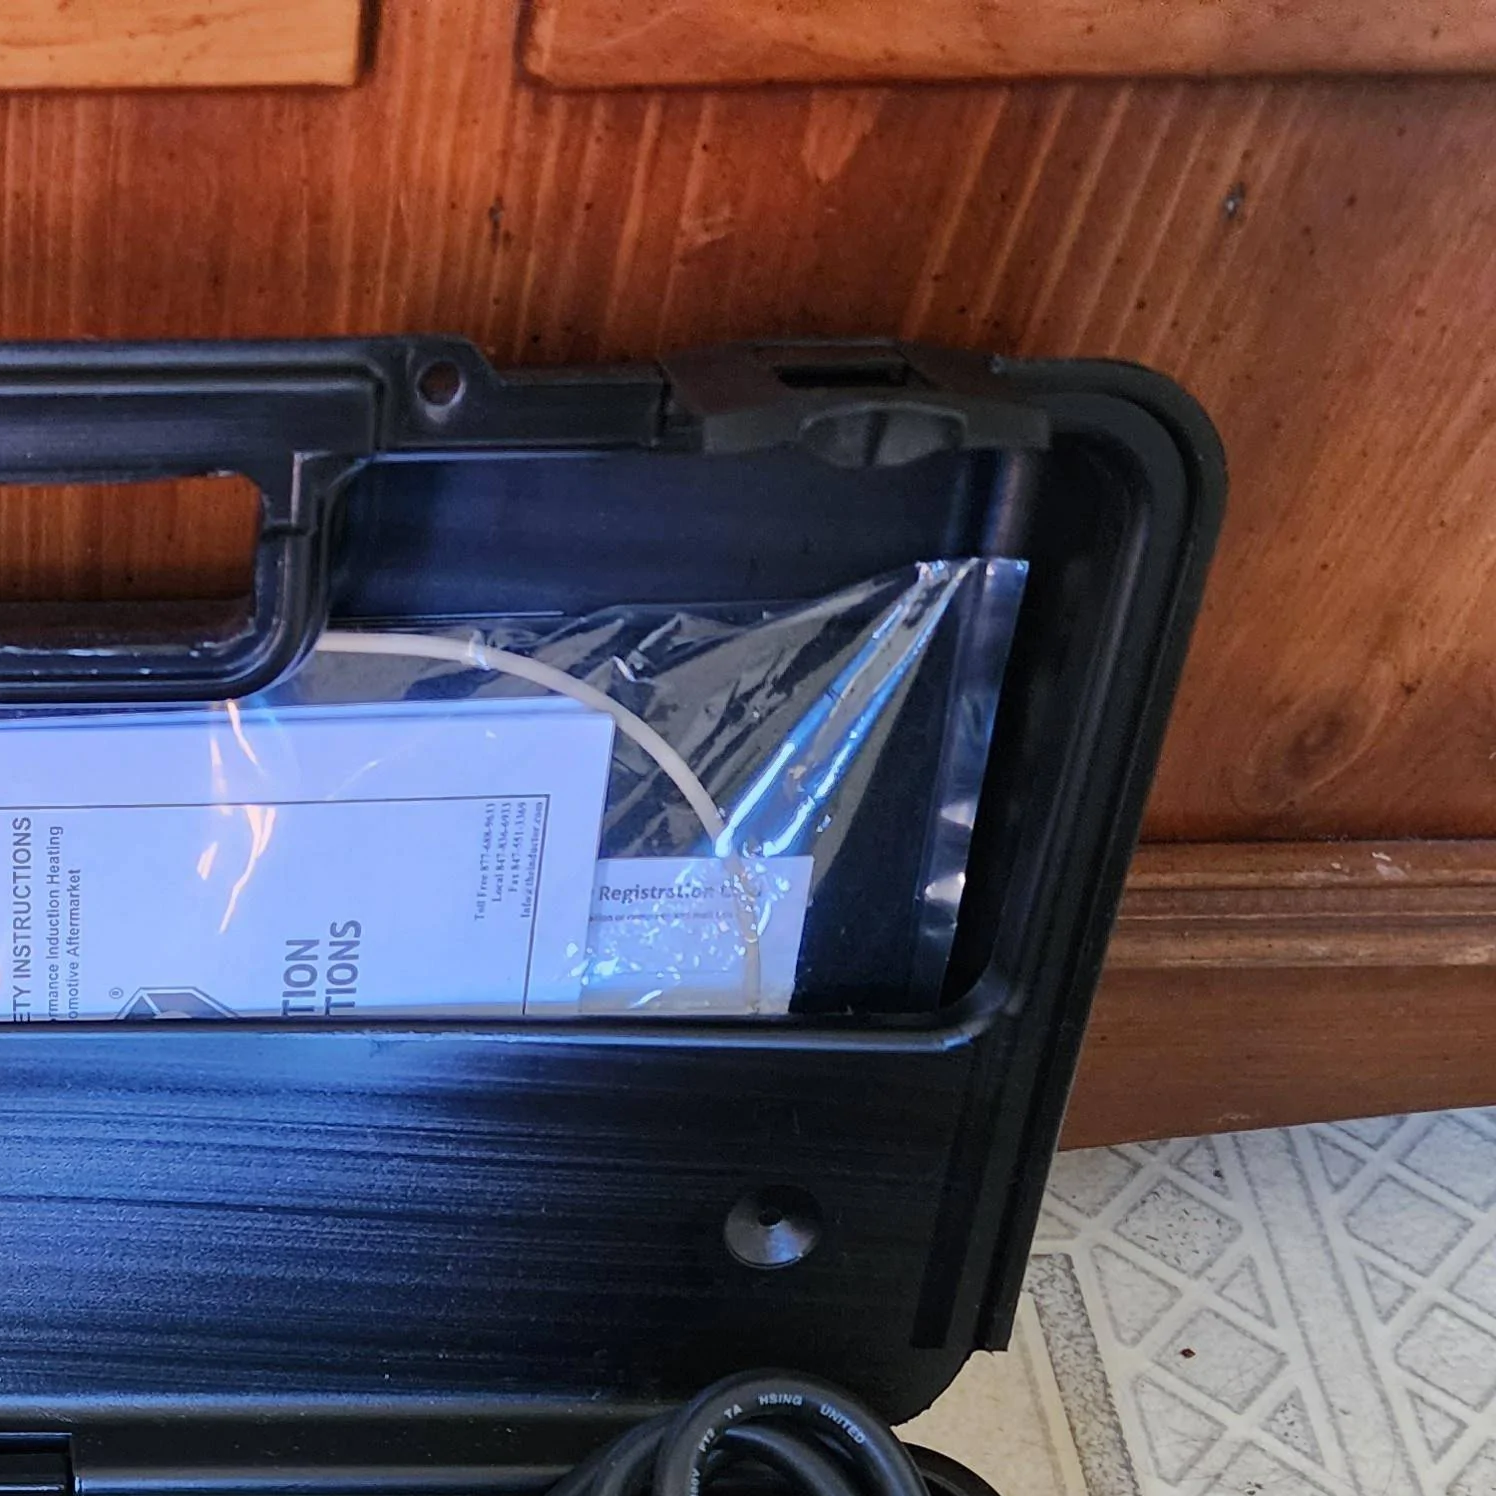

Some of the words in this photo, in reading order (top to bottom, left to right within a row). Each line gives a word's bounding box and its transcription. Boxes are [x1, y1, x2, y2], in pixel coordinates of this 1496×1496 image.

[45, 826, 64, 893] Heating
[12, 816, 32, 979] INSTRUCTIONS
[45, 896, 61, 960] Induction
[67, 869, 82, 957] Aftermarket
[48, 963, 60, 1022] rmance
[281, 939, 320, 1016] TION
[324, 920, 362, 1016] TIONS
[724, 1404, 743, 1420] TA
[758, 1394, 803, 1406] HSING
[819, 1403, 867, 1444] UNITED
